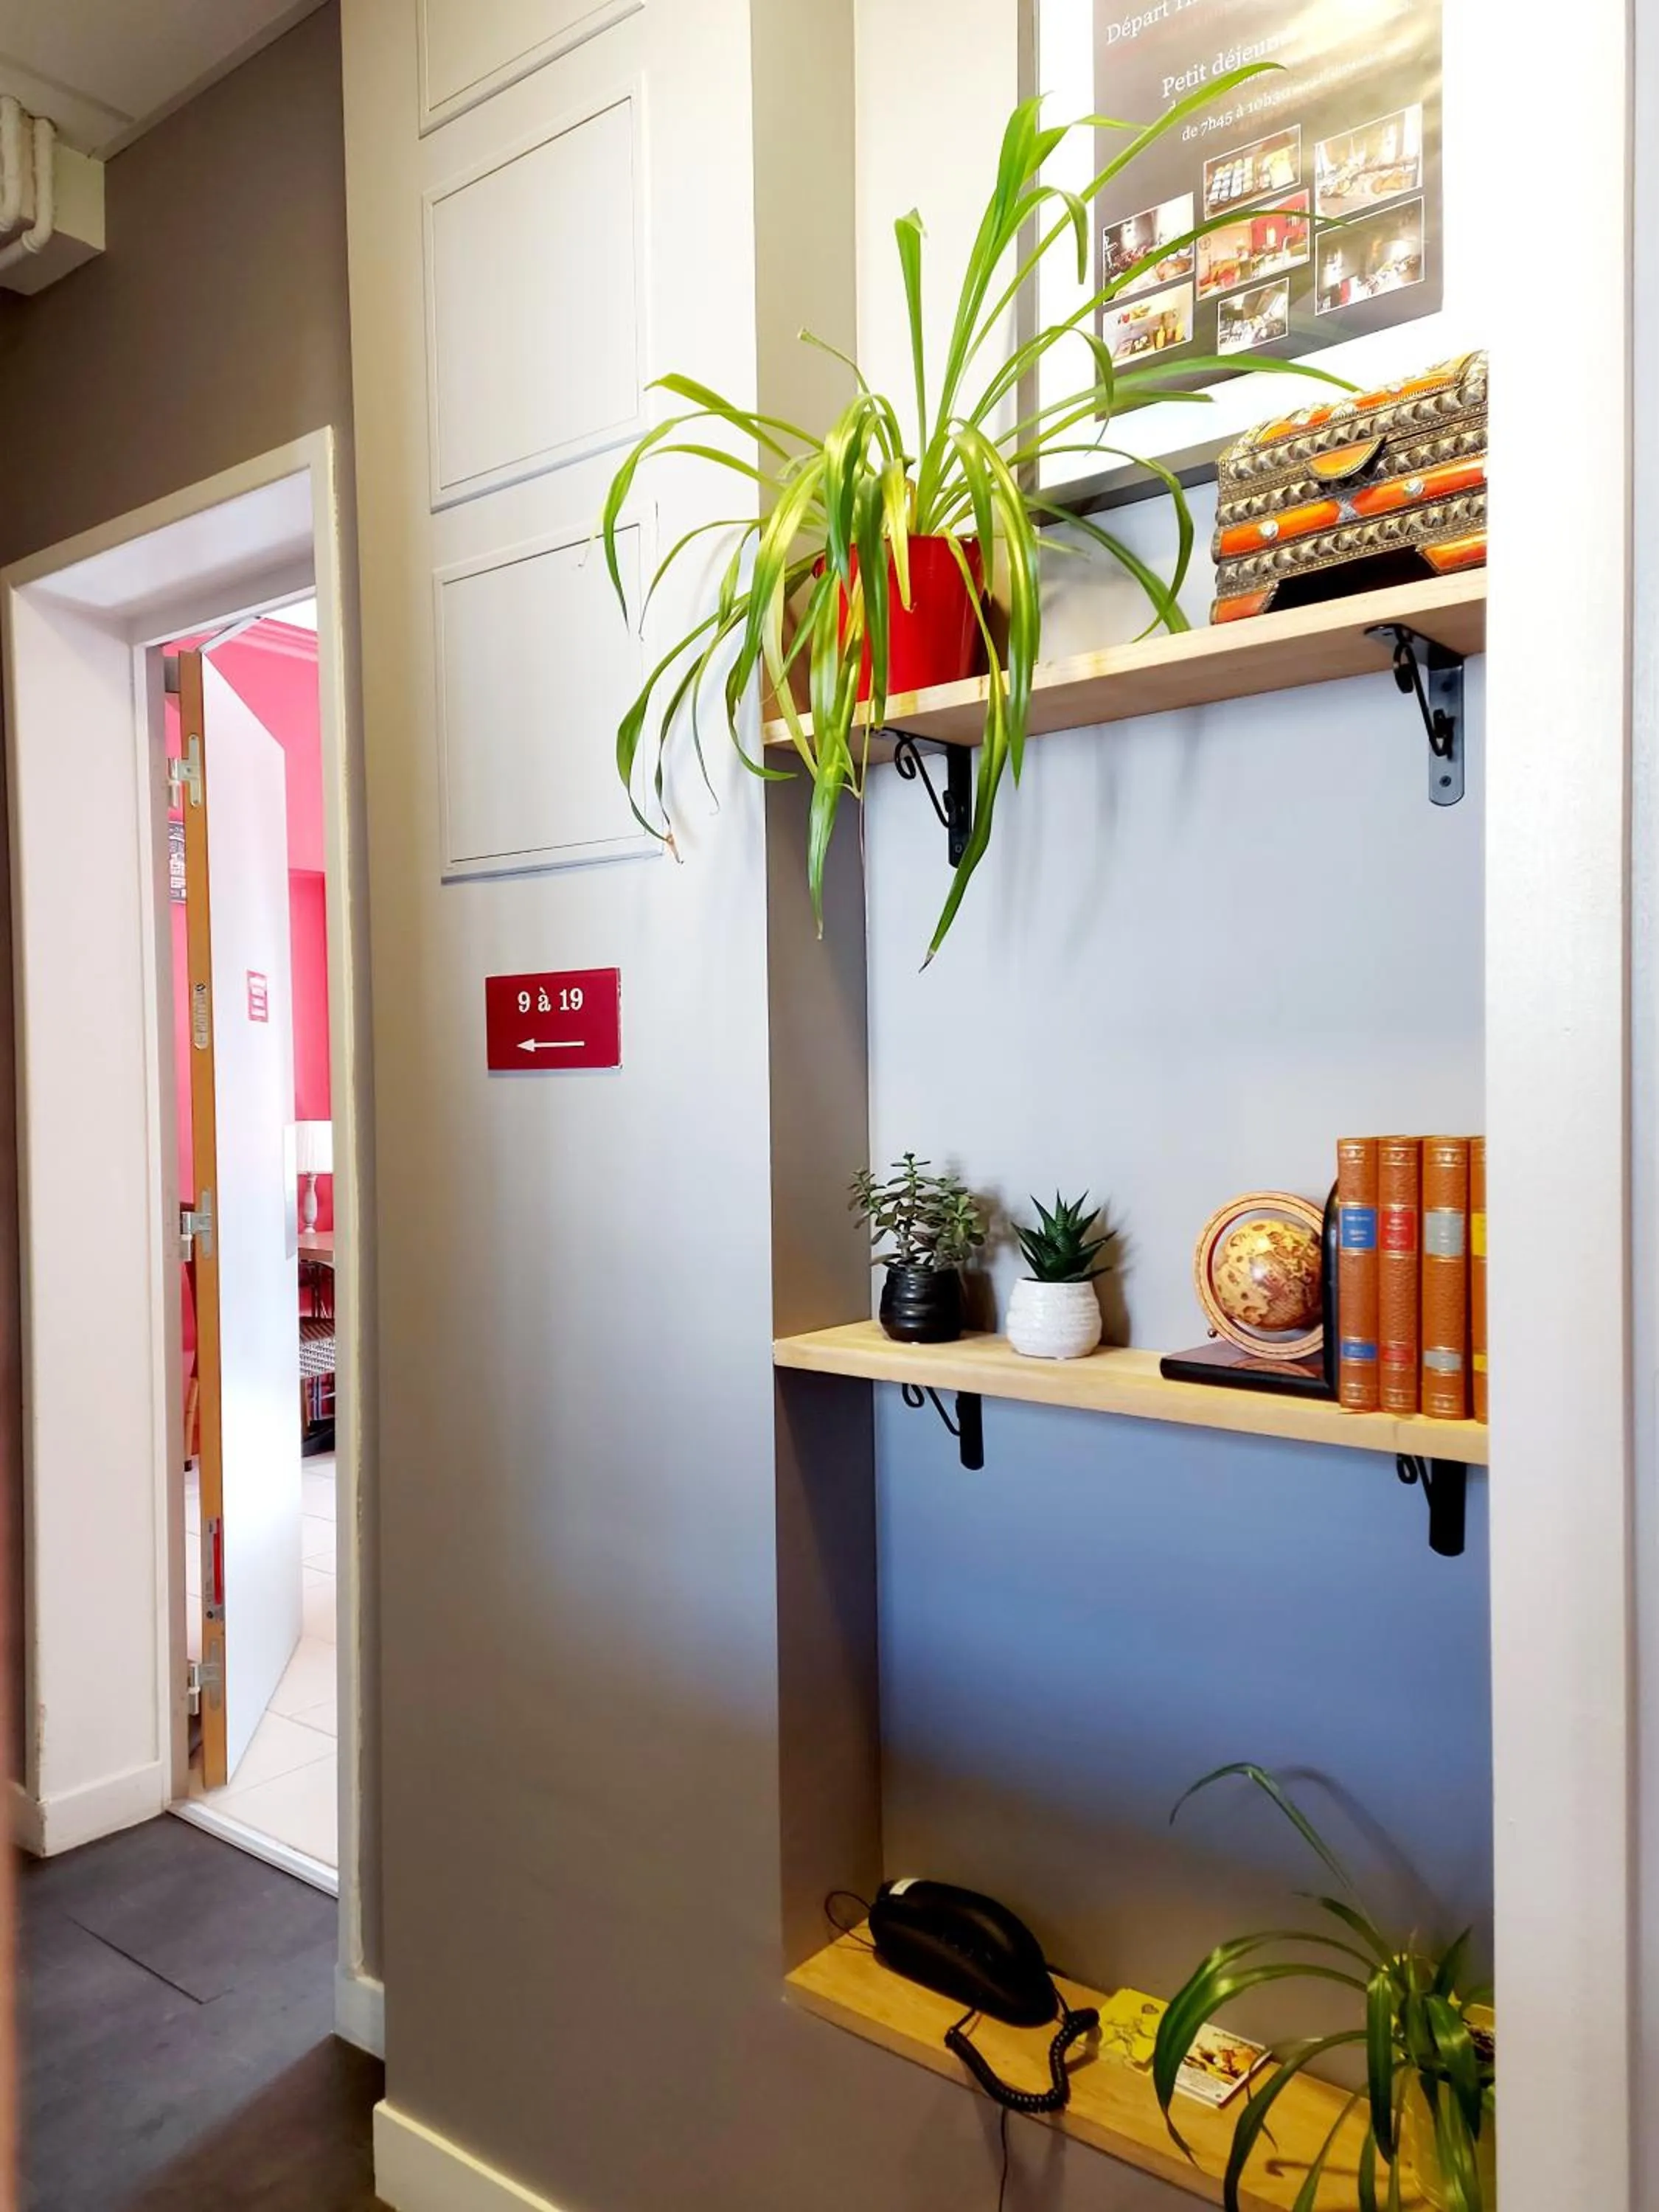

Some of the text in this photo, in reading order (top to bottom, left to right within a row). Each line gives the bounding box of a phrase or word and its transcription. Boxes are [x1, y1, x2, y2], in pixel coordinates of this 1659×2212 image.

[1106, 2, 1169, 45] Départ
[1162, 63, 1206, 98] Petit
[1182, 125, 1198, 142] de
[1200, 111, 1234, 136] 7h45
[518, 986, 584, 1013] 9 à 19
